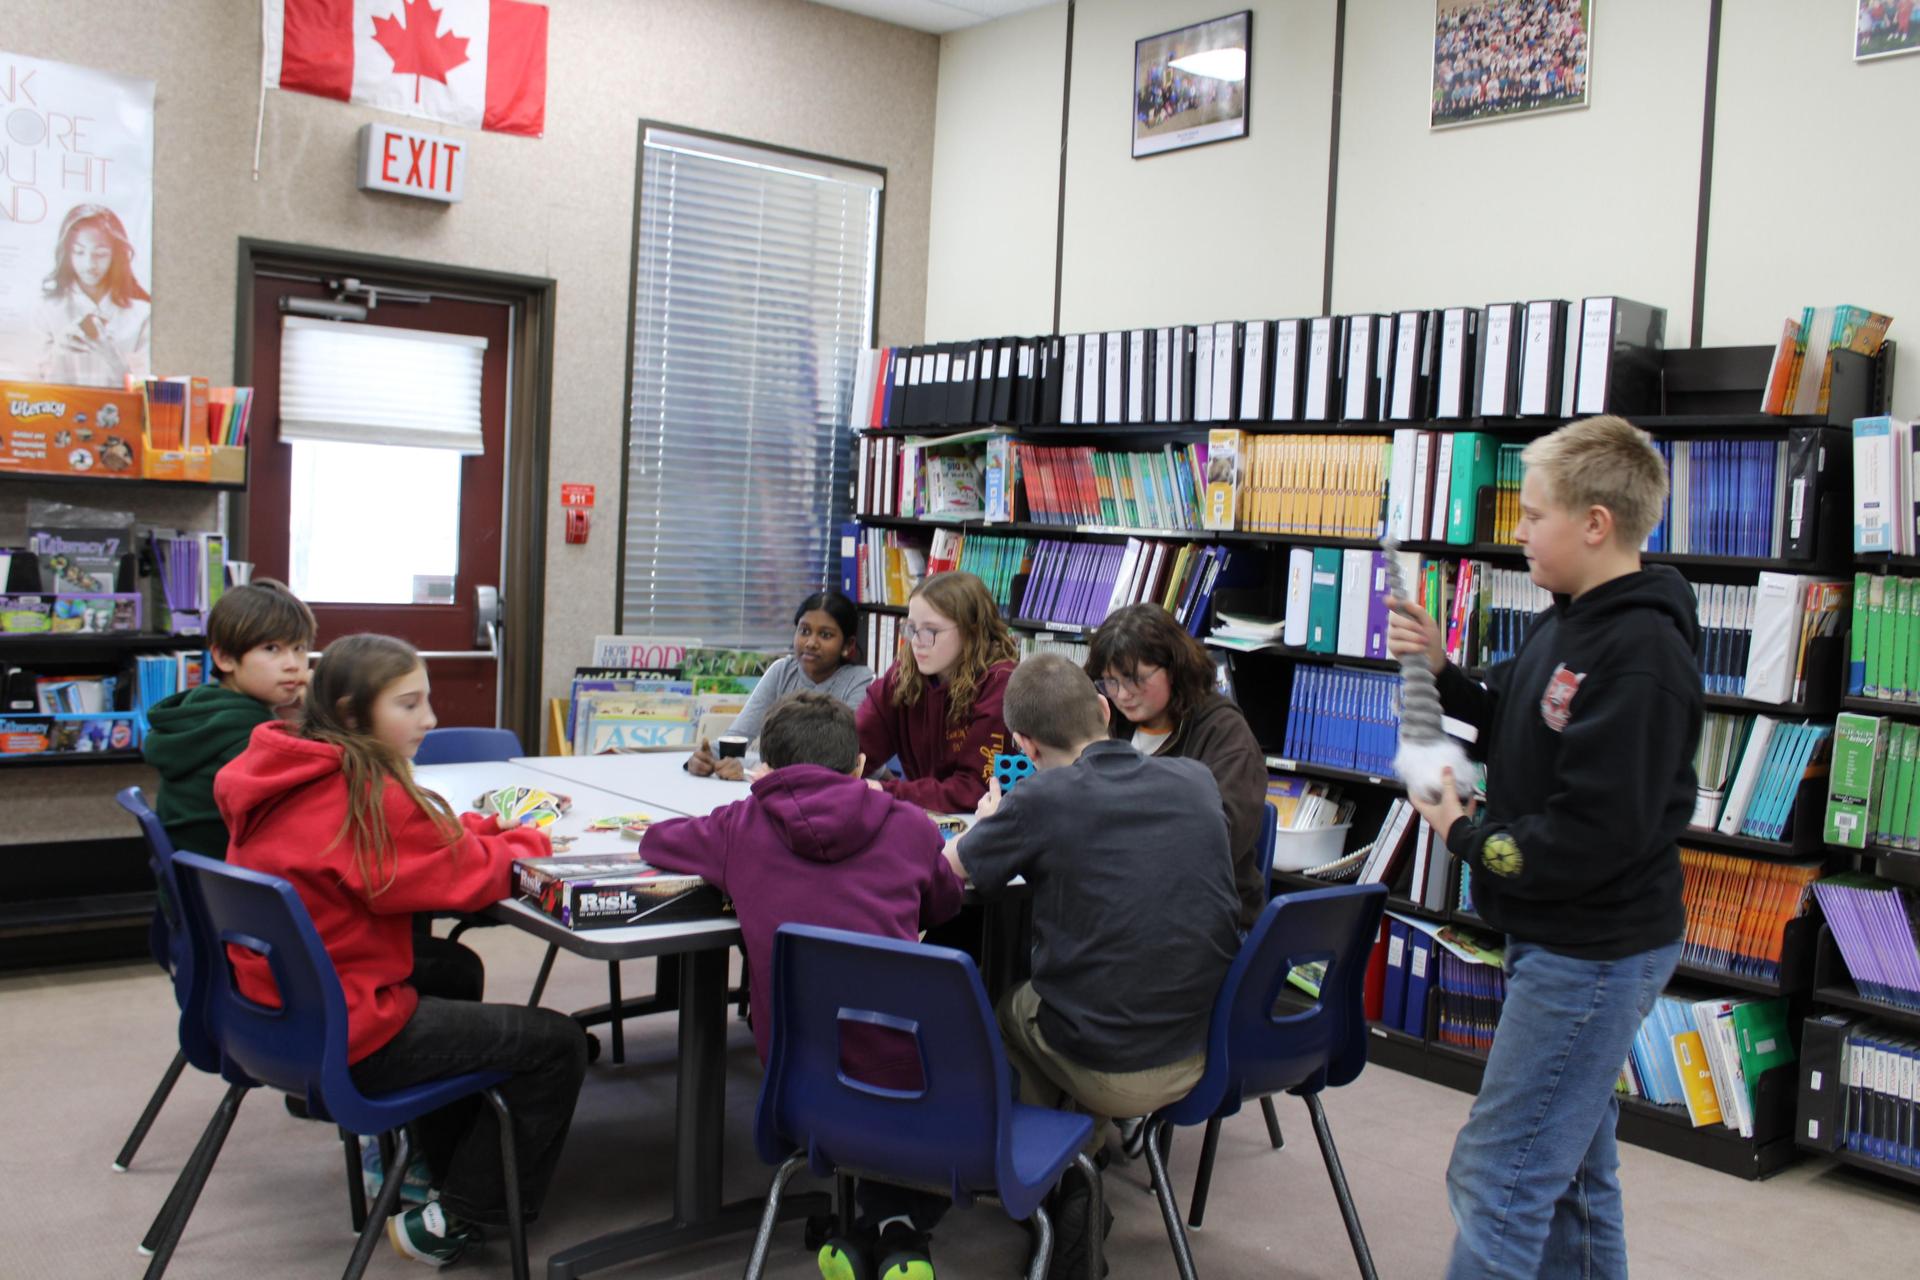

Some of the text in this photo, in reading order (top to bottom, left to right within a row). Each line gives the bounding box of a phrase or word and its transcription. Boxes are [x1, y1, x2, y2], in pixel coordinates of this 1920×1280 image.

[61, 153, 115, 194] HIT
[381, 131, 461, 193] EXIT
[10, 399, 67, 418] Literacy
[569, 494, 586, 505] 911
[36, 531, 106, 557] Literacy
[603, 645, 628, 657] HOW
[604, 726, 670, 749] ASK
[520, 868, 542, 893] Risk
[579, 891, 638, 912] Risk
